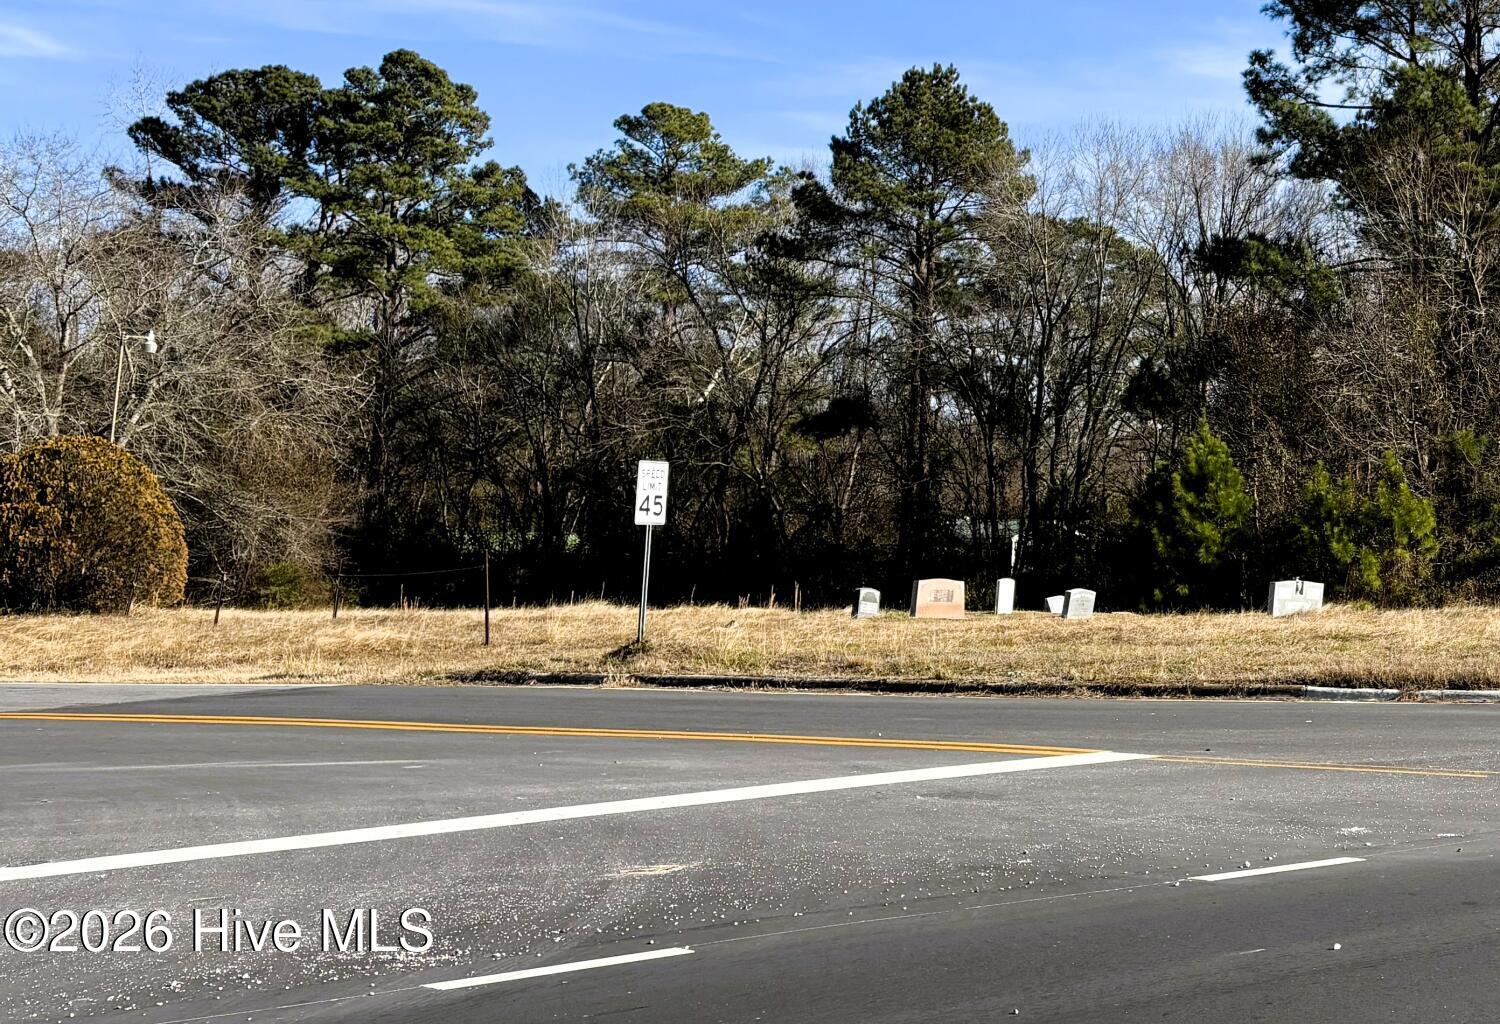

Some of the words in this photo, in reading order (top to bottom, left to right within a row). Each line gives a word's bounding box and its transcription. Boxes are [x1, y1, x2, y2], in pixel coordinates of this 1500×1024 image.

[641, 468, 665, 479] SPEED
[642, 482, 662, 492] LIMIT
[639, 494, 663, 516] 45
